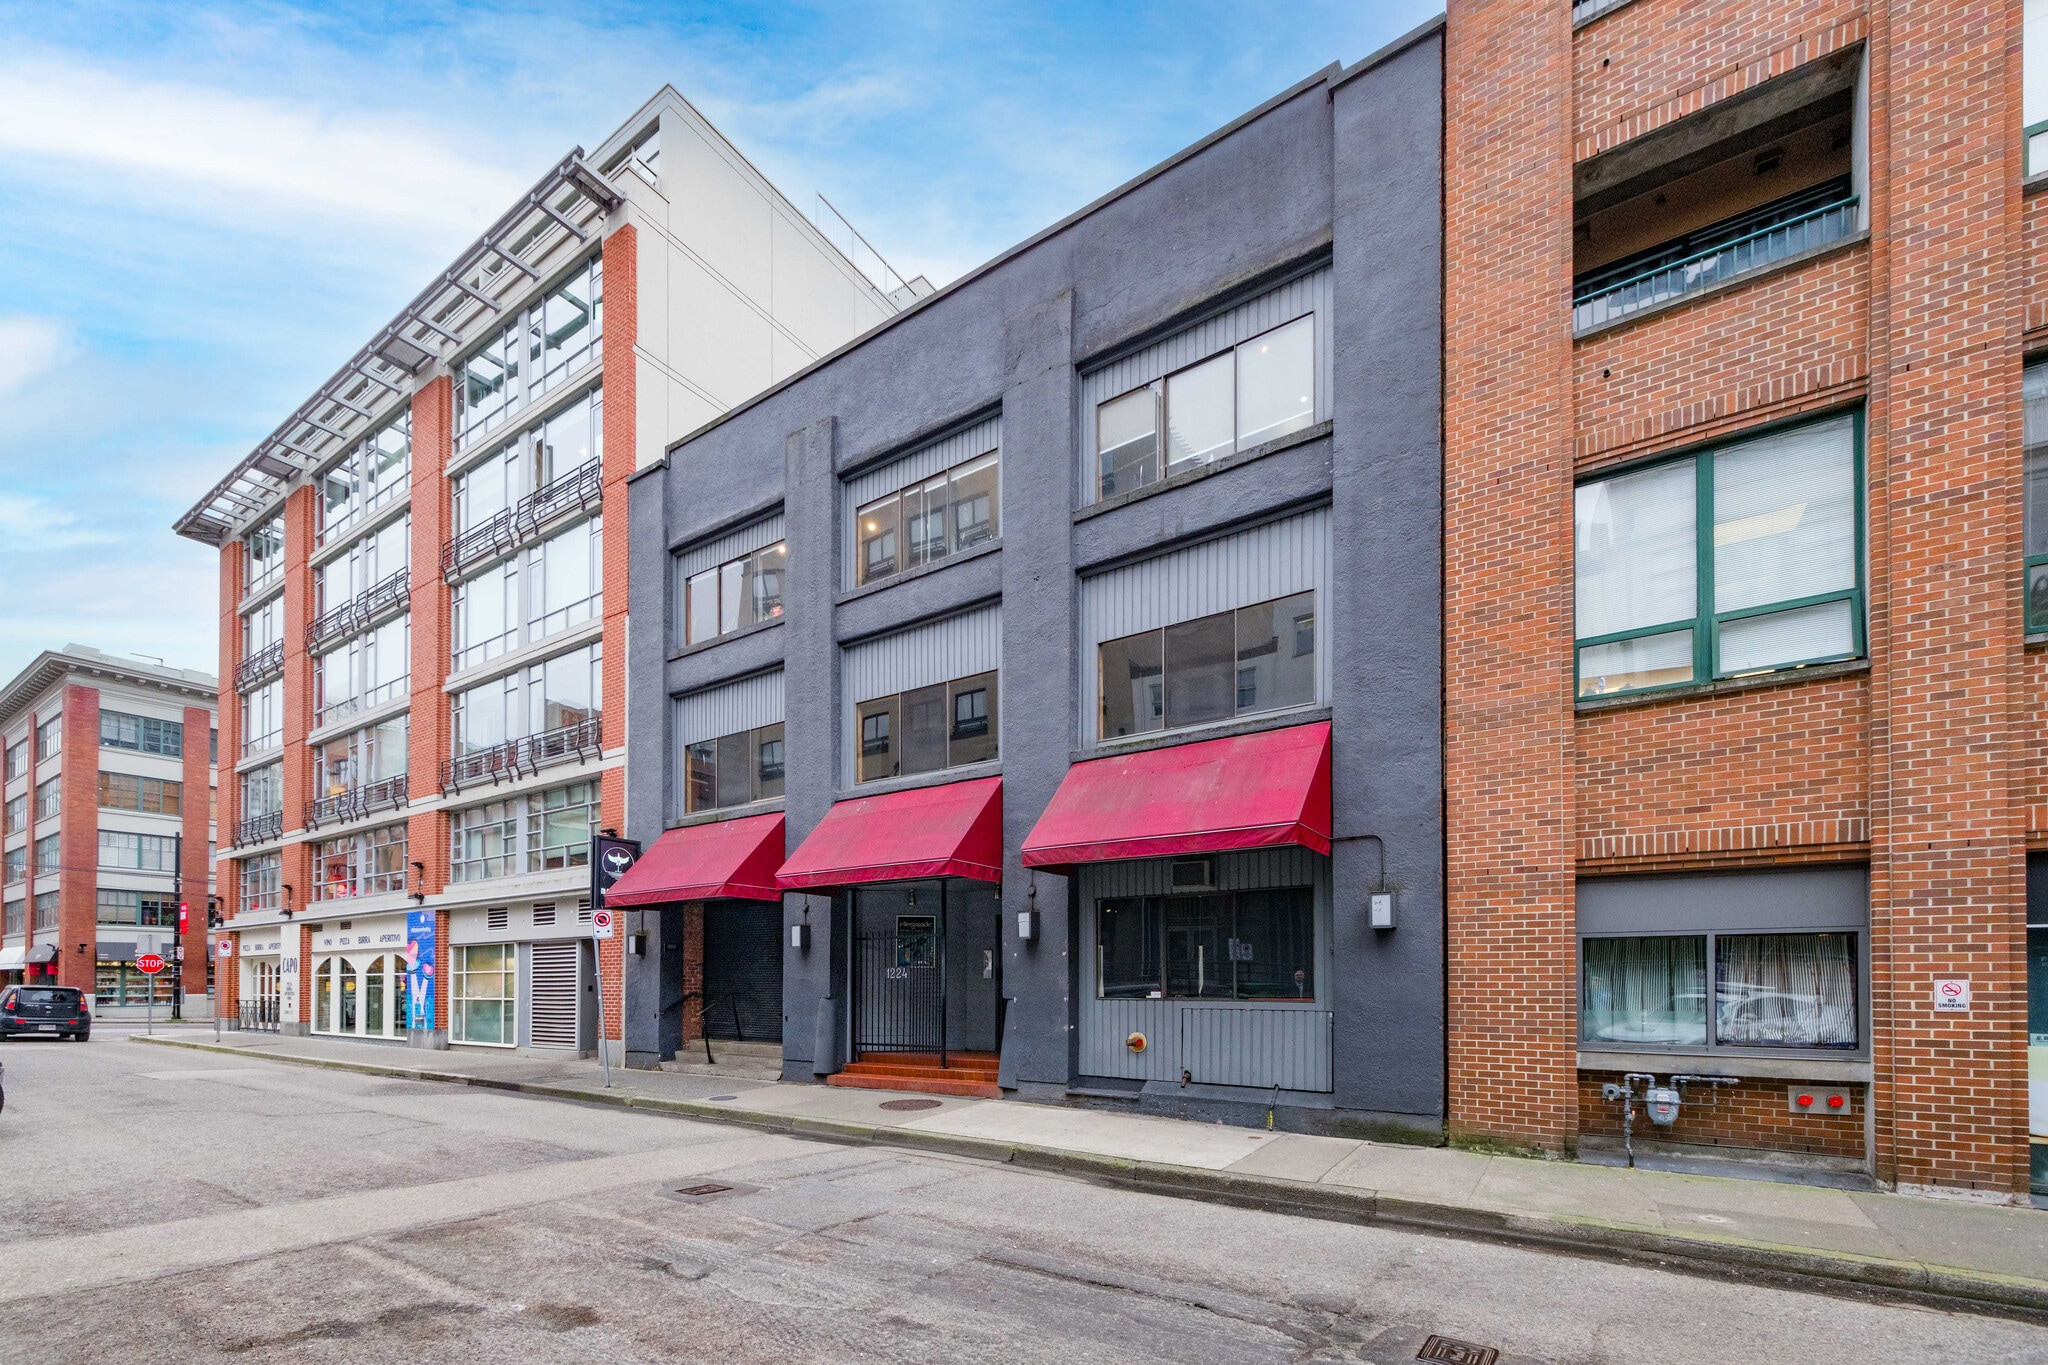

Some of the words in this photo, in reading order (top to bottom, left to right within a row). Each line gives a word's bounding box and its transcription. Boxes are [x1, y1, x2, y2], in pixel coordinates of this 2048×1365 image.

[339, 937, 350, 945] PIZZA
[379, 934, 401, 943] APERITIVO
[138, 959, 163, 968] STOP
[282, 957, 298, 973] CAPO
[887, 967, 908, 979] 1224
